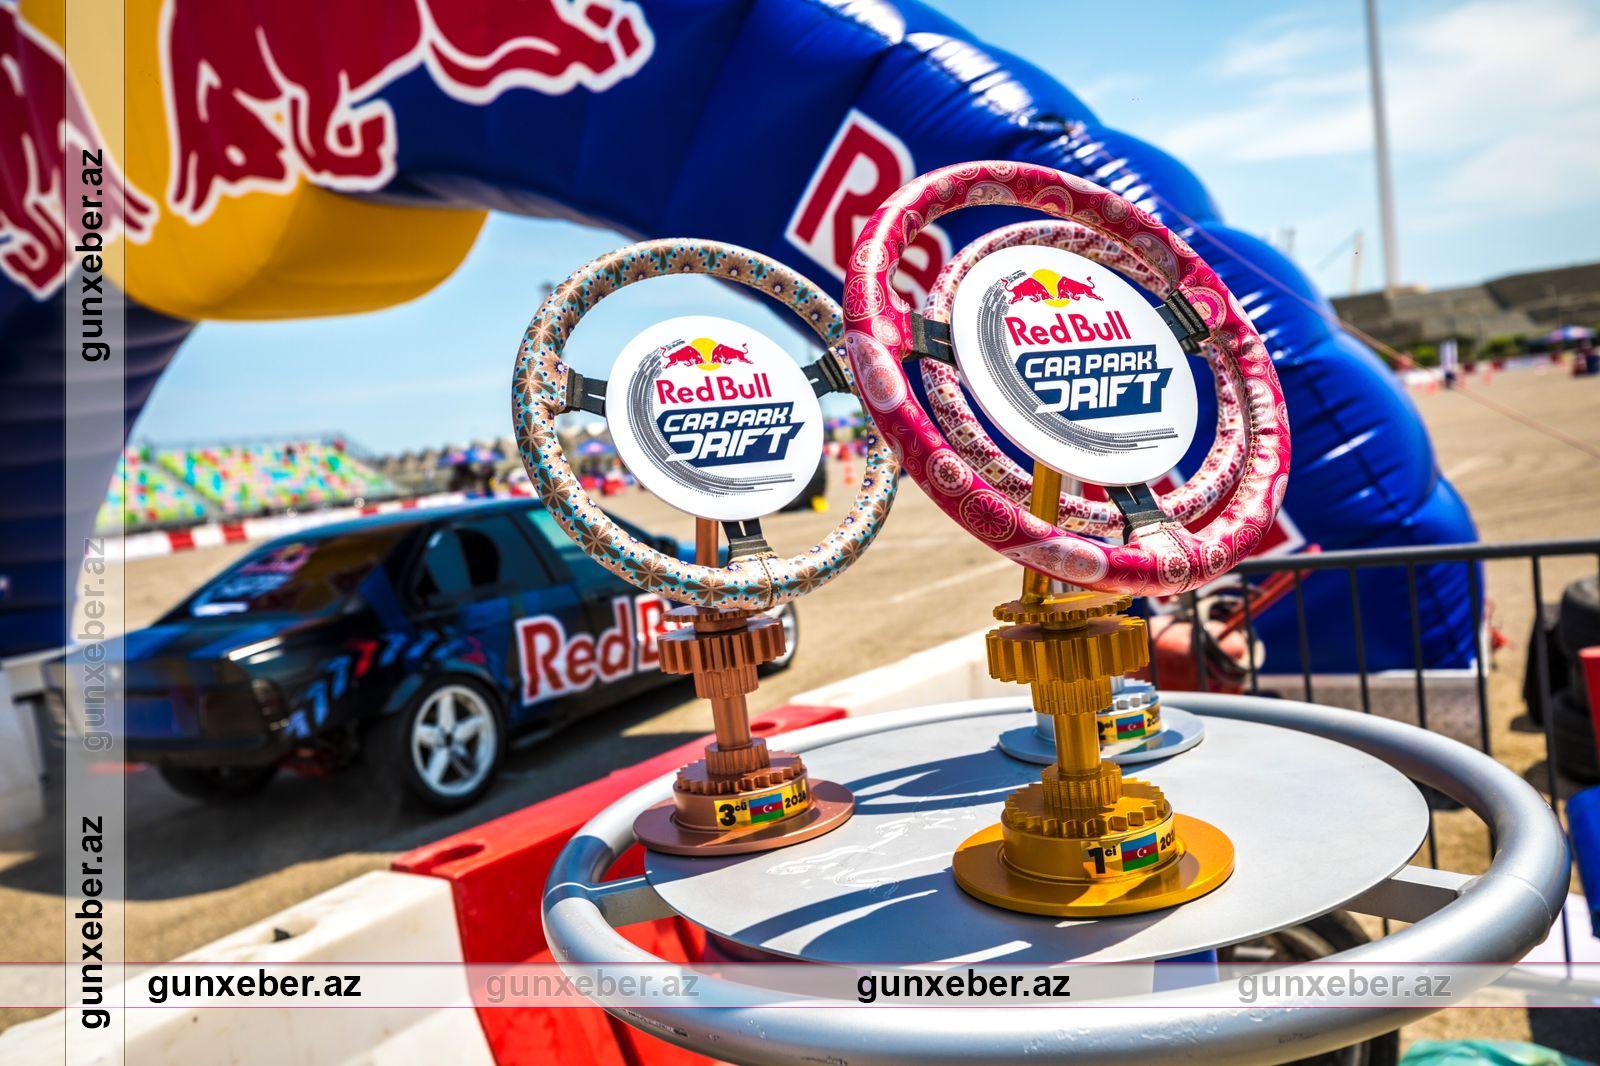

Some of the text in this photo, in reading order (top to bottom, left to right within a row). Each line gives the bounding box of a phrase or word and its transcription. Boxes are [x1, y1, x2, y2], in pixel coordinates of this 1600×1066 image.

[1005, 310, 1131, 346] Red Bull
[1025, 351, 1152, 379] CAR PARK
[656, 373, 772, 405] Red Bull
[1033, 372, 1162, 414] DRIFT
[663, 407, 789, 433] CAR PARK
[664, 425, 793, 462] DRIFT
[512, 595, 635, 706] Red
[1088, 845, 1117, 874] 1ci
